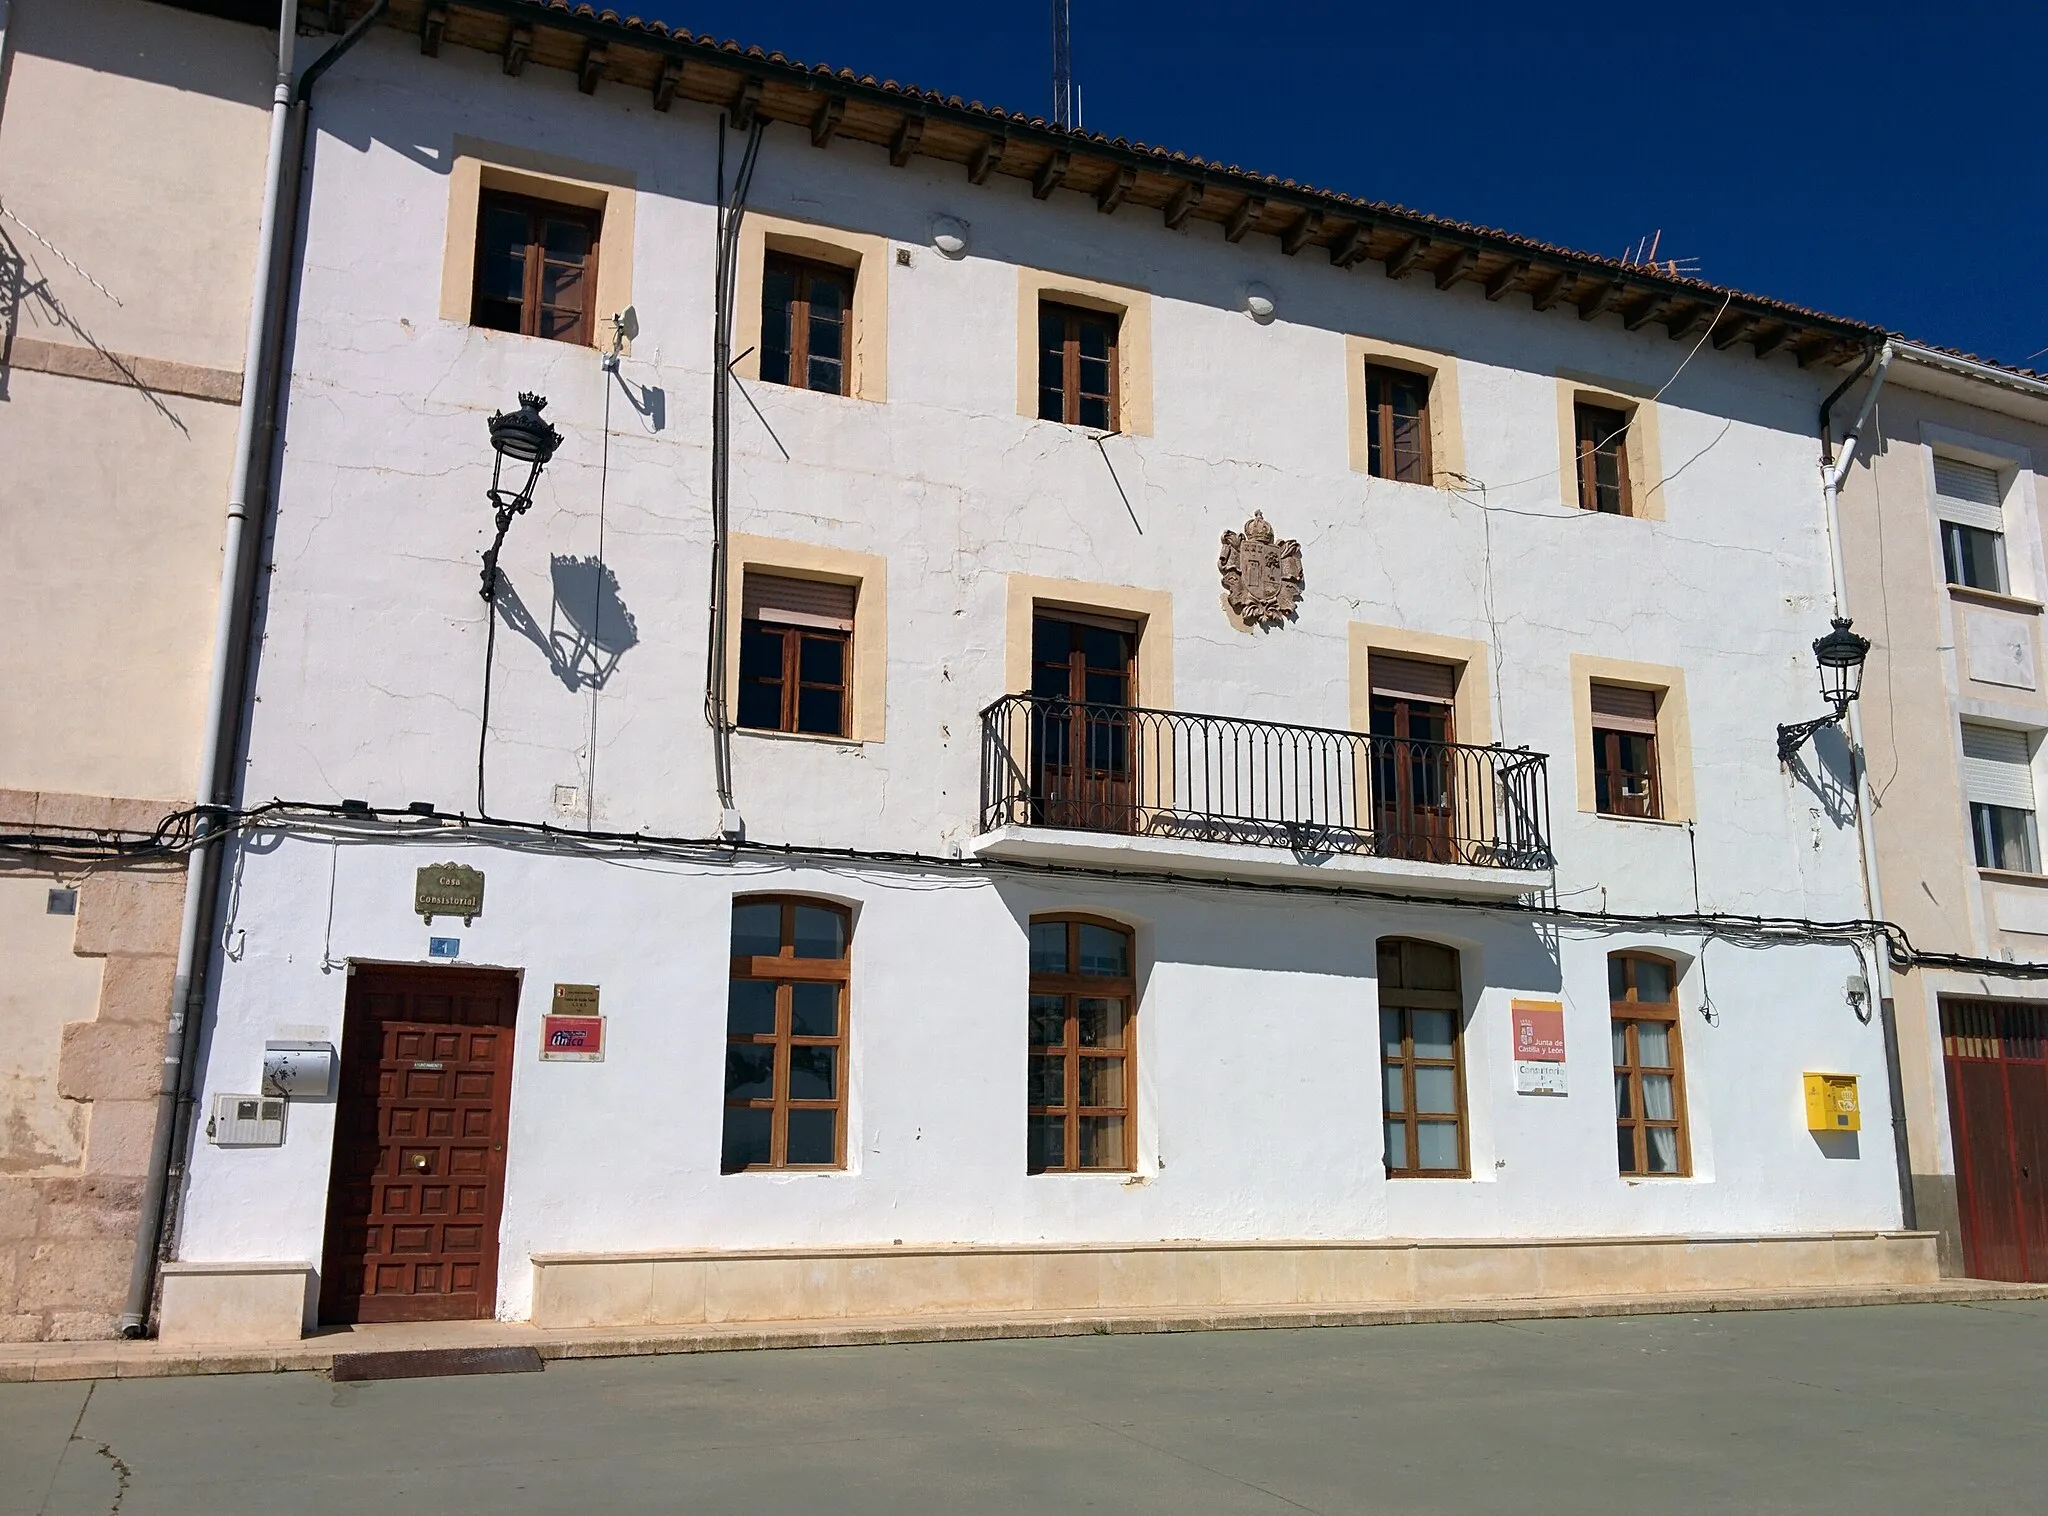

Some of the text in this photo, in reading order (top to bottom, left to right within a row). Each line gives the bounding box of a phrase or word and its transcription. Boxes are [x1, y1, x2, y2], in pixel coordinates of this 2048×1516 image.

[440, 877, 460, 886] Casa
[420, 895, 476, 906] Consistorial
[442, 942, 448, 954] 1
[1555, 1039, 1564, 1047] de
